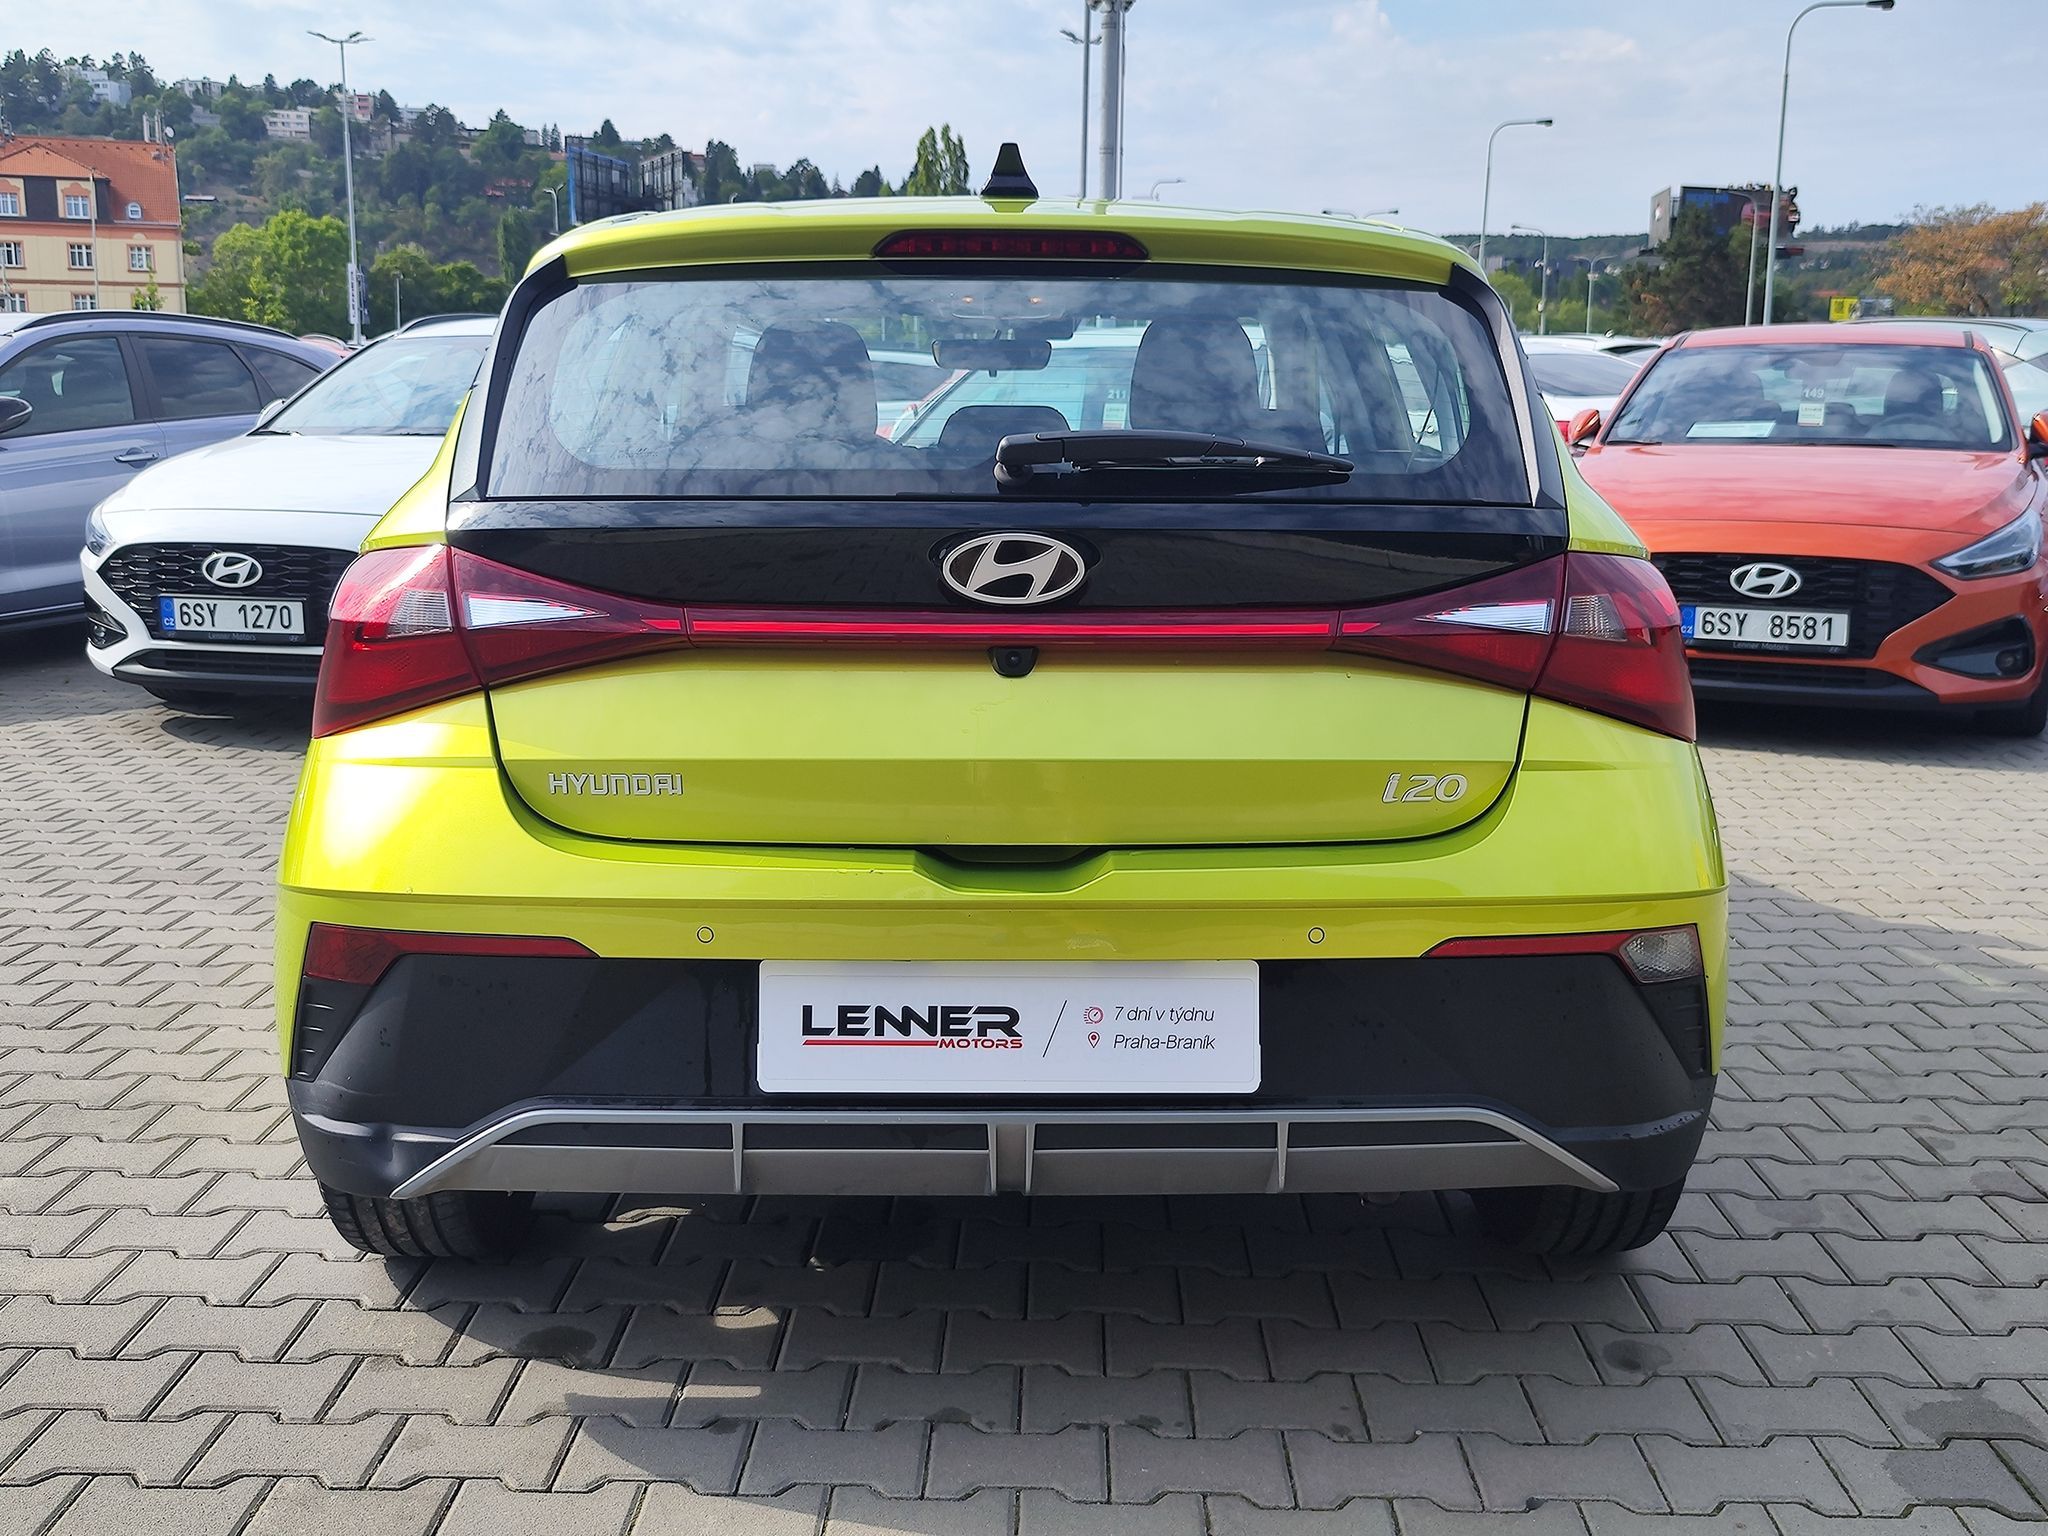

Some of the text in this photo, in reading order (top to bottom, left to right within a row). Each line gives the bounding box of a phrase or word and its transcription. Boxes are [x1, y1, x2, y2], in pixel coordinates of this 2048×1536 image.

[163, 602, 292, 630] CZ 6SY 1270
[1680, 610, 1833, 641] CZ 6SY 8581
[548, 772, 684, 796] HYUNDAI
[1381, 772, 1468, 803] i20
[802, 1004, 1023, 1037] LENNER
[1114, 1006, 1215, 1025] 7 dní v týdnu
[939, 1038, 1023, 1049] MOTORS
[1113, 1034, 1217, 1050] Praha-Braník
